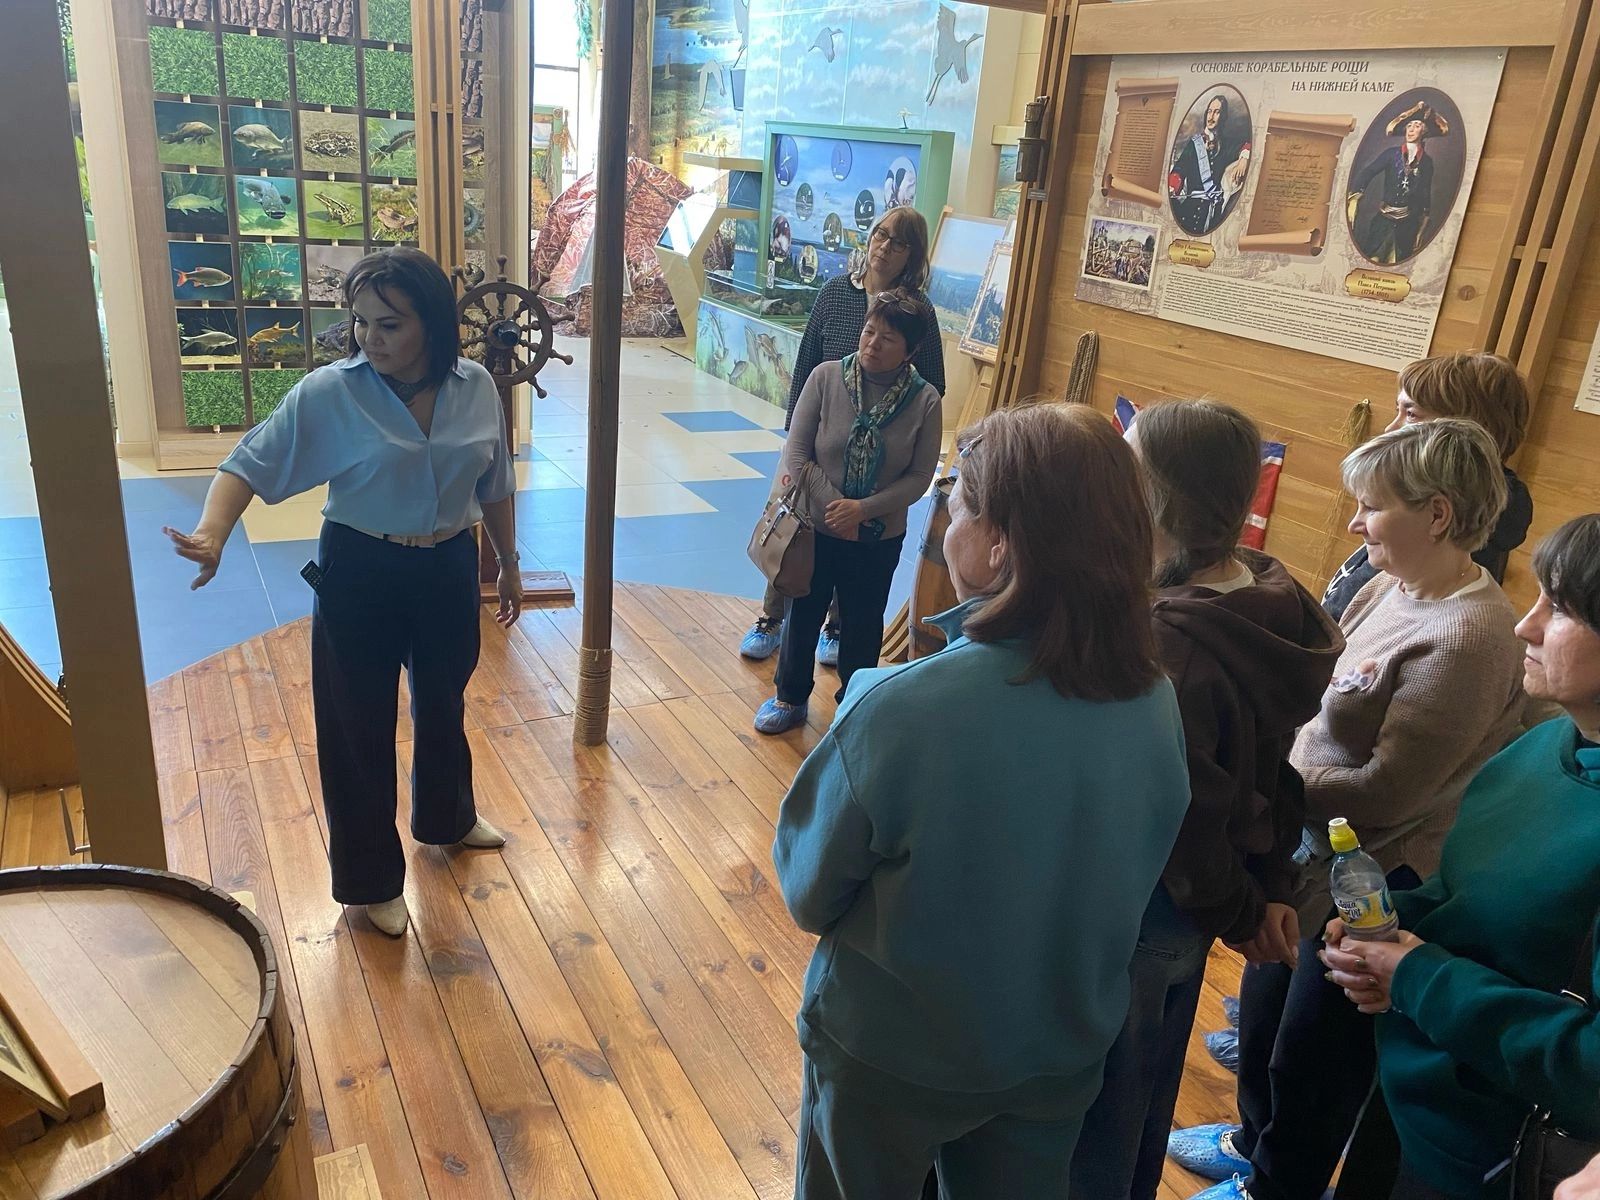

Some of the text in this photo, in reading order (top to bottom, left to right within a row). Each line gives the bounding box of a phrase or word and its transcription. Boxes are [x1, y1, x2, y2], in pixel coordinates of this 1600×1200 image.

[1190, 61, 1370, 75] СОСНОВЫЕ КОРАБЕЛЬНЫЕ РОЩИ
[1291, 78, 1395, 92] НА НИЖНЕЙ КАМЕ
